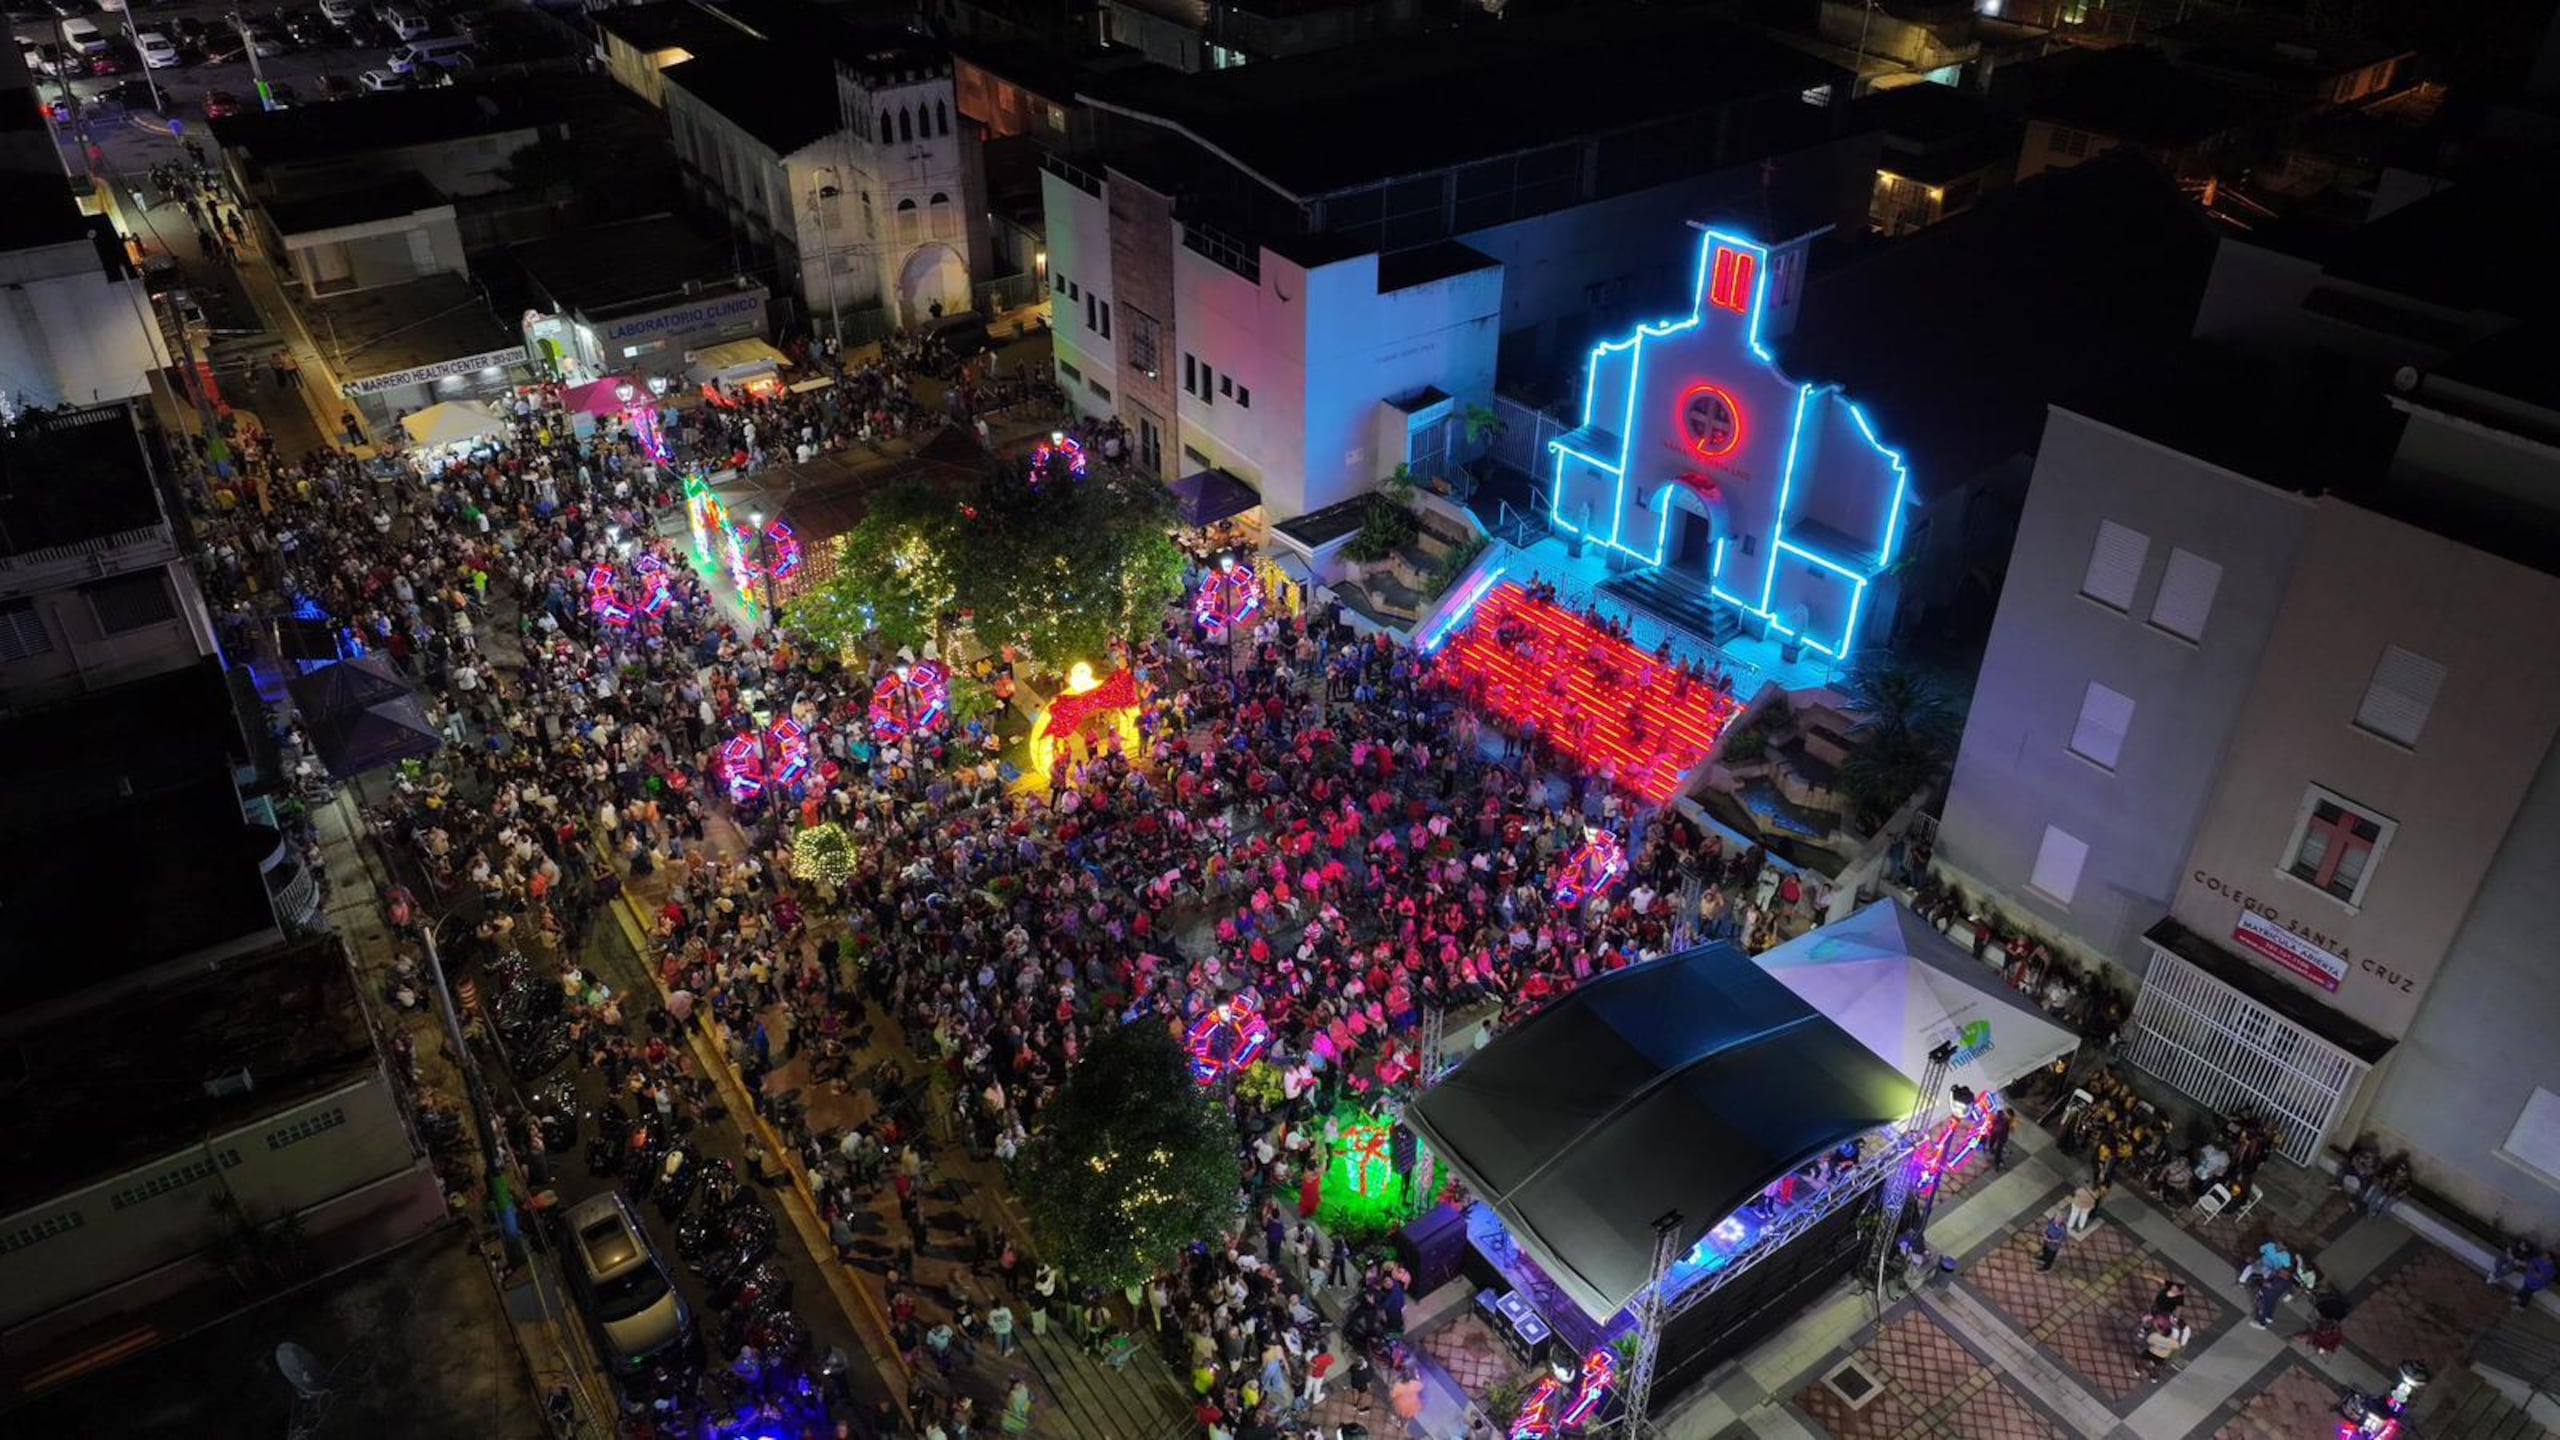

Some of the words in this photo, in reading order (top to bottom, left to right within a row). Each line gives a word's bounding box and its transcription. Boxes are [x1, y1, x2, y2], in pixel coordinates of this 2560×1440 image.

[608, 308, 702, 339] LABORATORIO
[361, 373, 411, 392] MARRERO
[413, 363, 449, 382] HEALTH
[451, 356, 488, 374] CENTER
[2194, 870, 2278, 920] COLEGIO
[2288, 919, 2350, 959] SANTA
[2361, 958, 2415, 993] CRUZ
